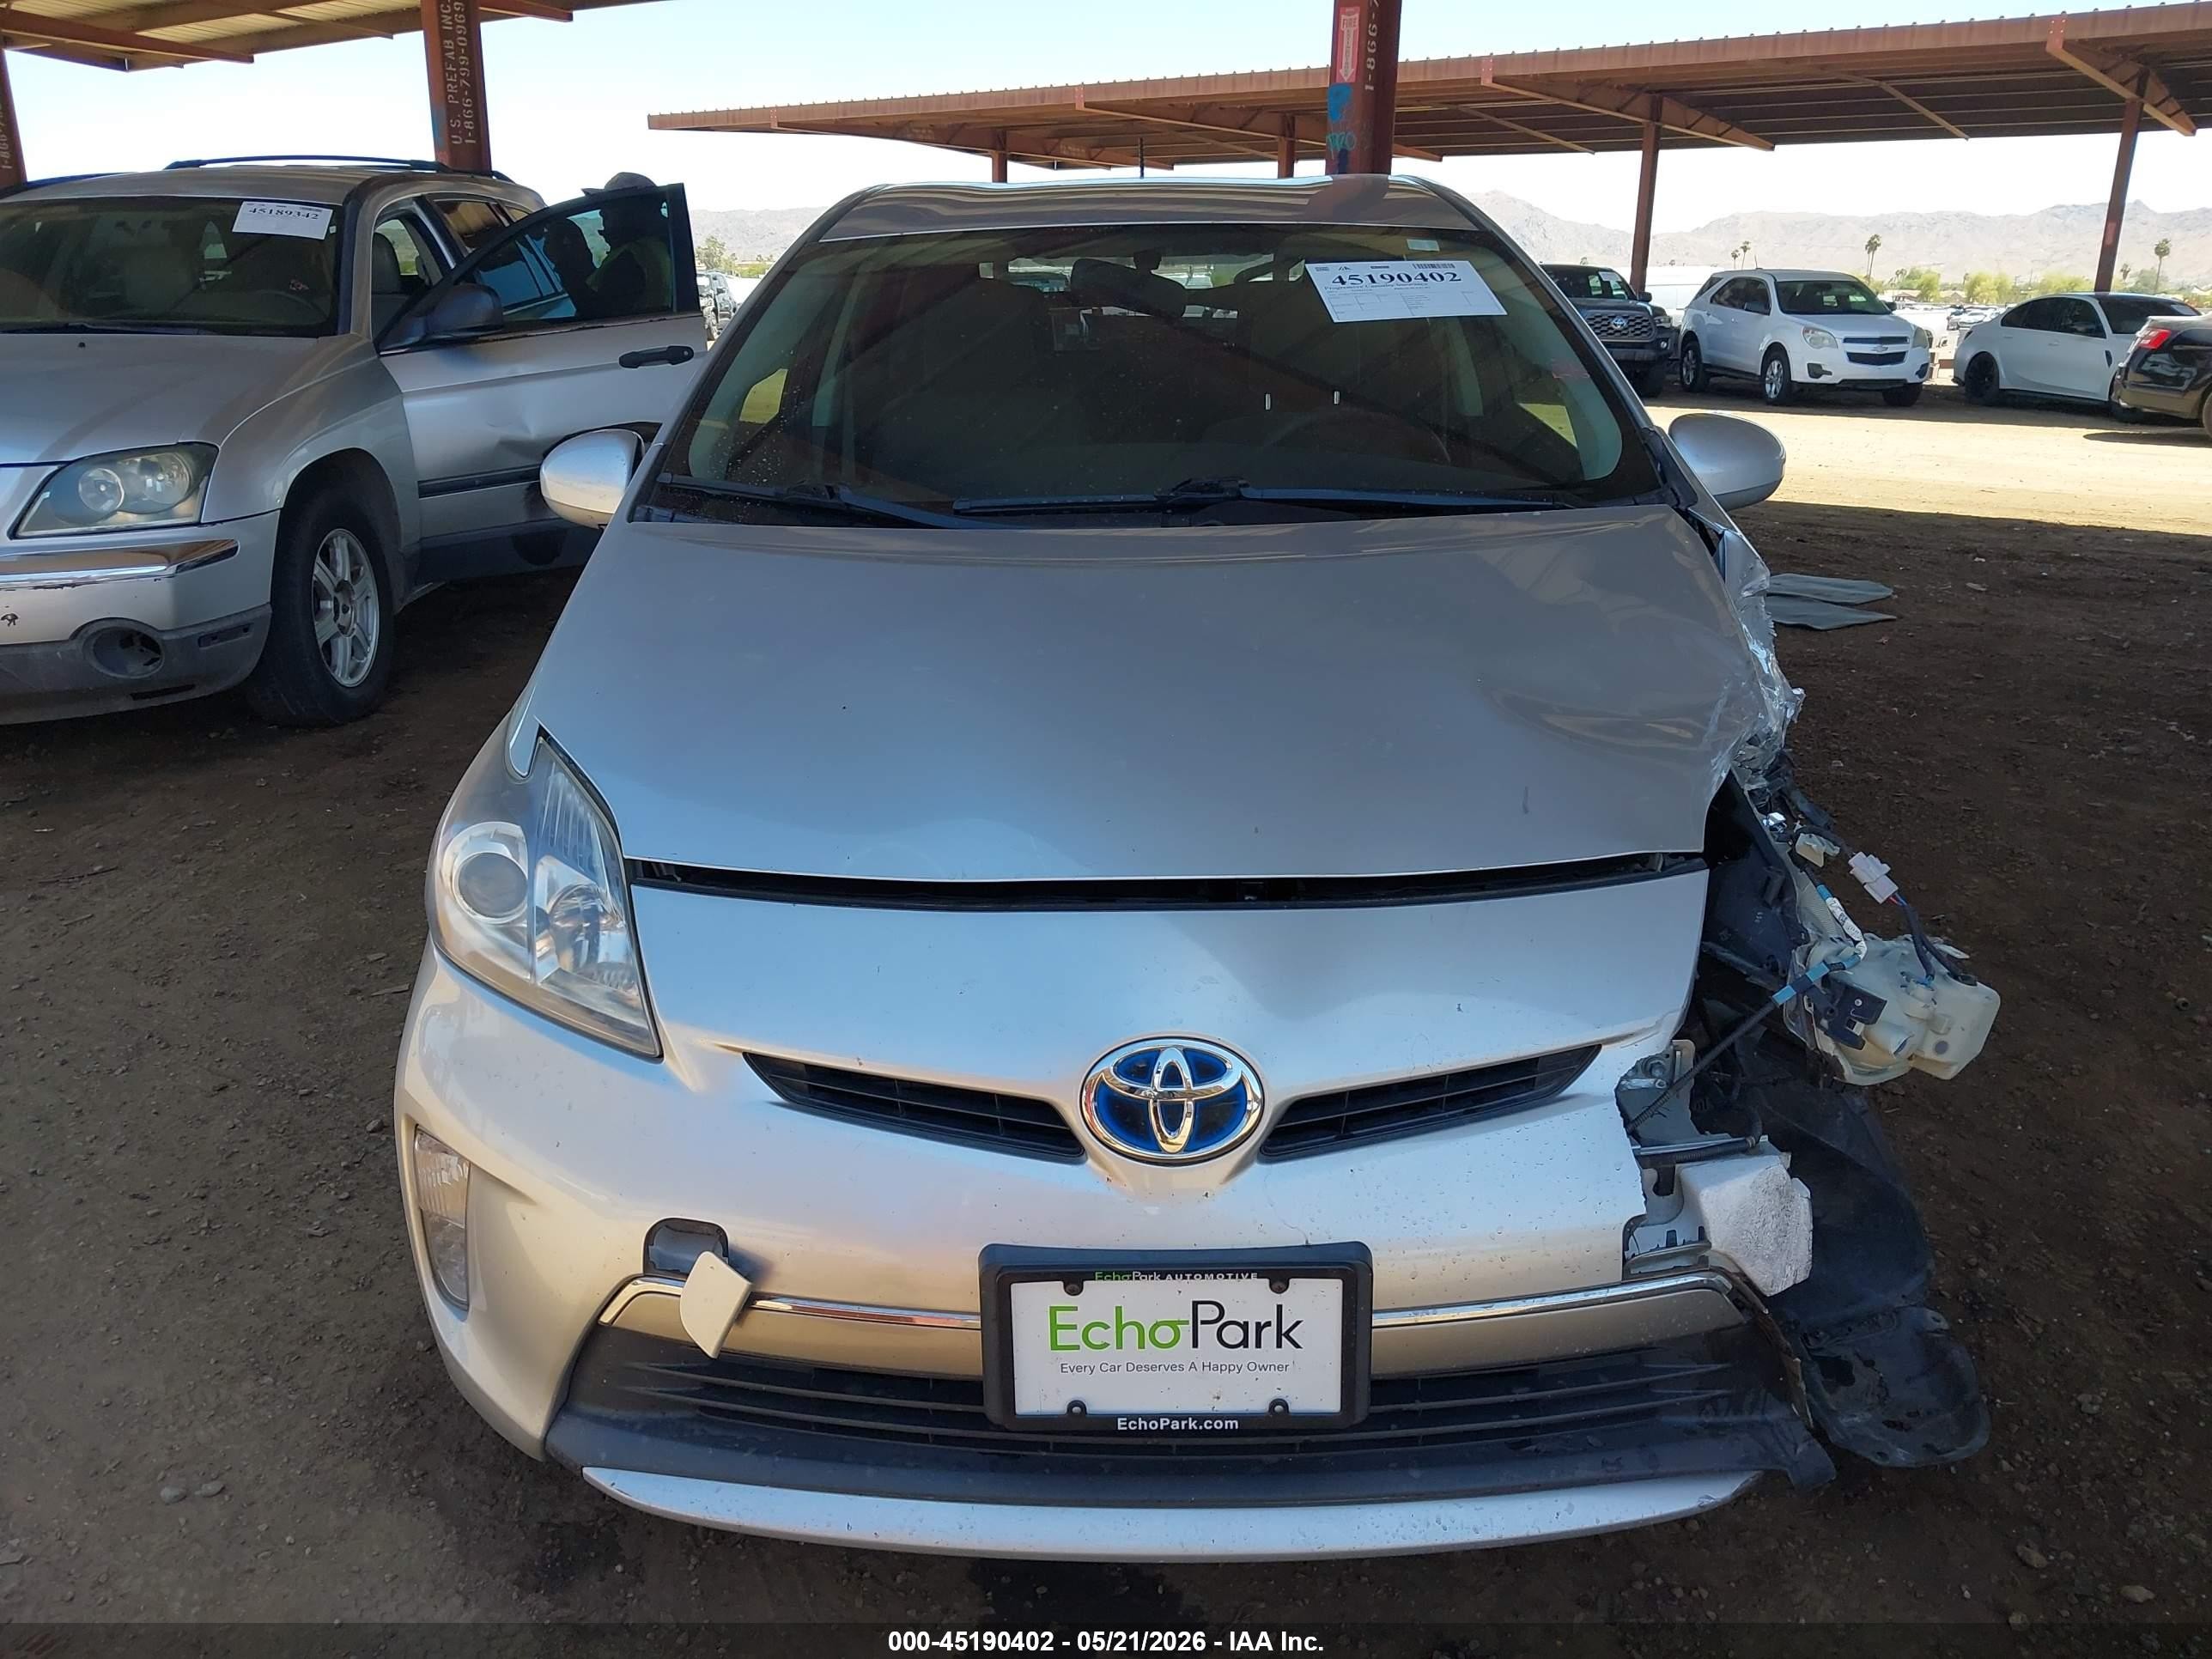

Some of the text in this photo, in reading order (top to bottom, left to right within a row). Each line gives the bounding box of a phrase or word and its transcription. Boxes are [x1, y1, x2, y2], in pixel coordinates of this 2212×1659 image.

[442, 40, 459, 104] PREFAB
[453, 0, 476, 144] 1-866-799-0969
[450, 113, 463, 144] U.S.
[249, 207, 319, 220] 45189342
[1332, 272, 1462, 286] 45190402
[1095, 1271, 1160, 1281] EchoPark
[1048, 1300, 1304, 1351] EchoPark
[1060, 1361, 1289, 1376] Every Car Deserves A Happy Owner
[1117, 1418, 1238, 1431] EchoPark.com
